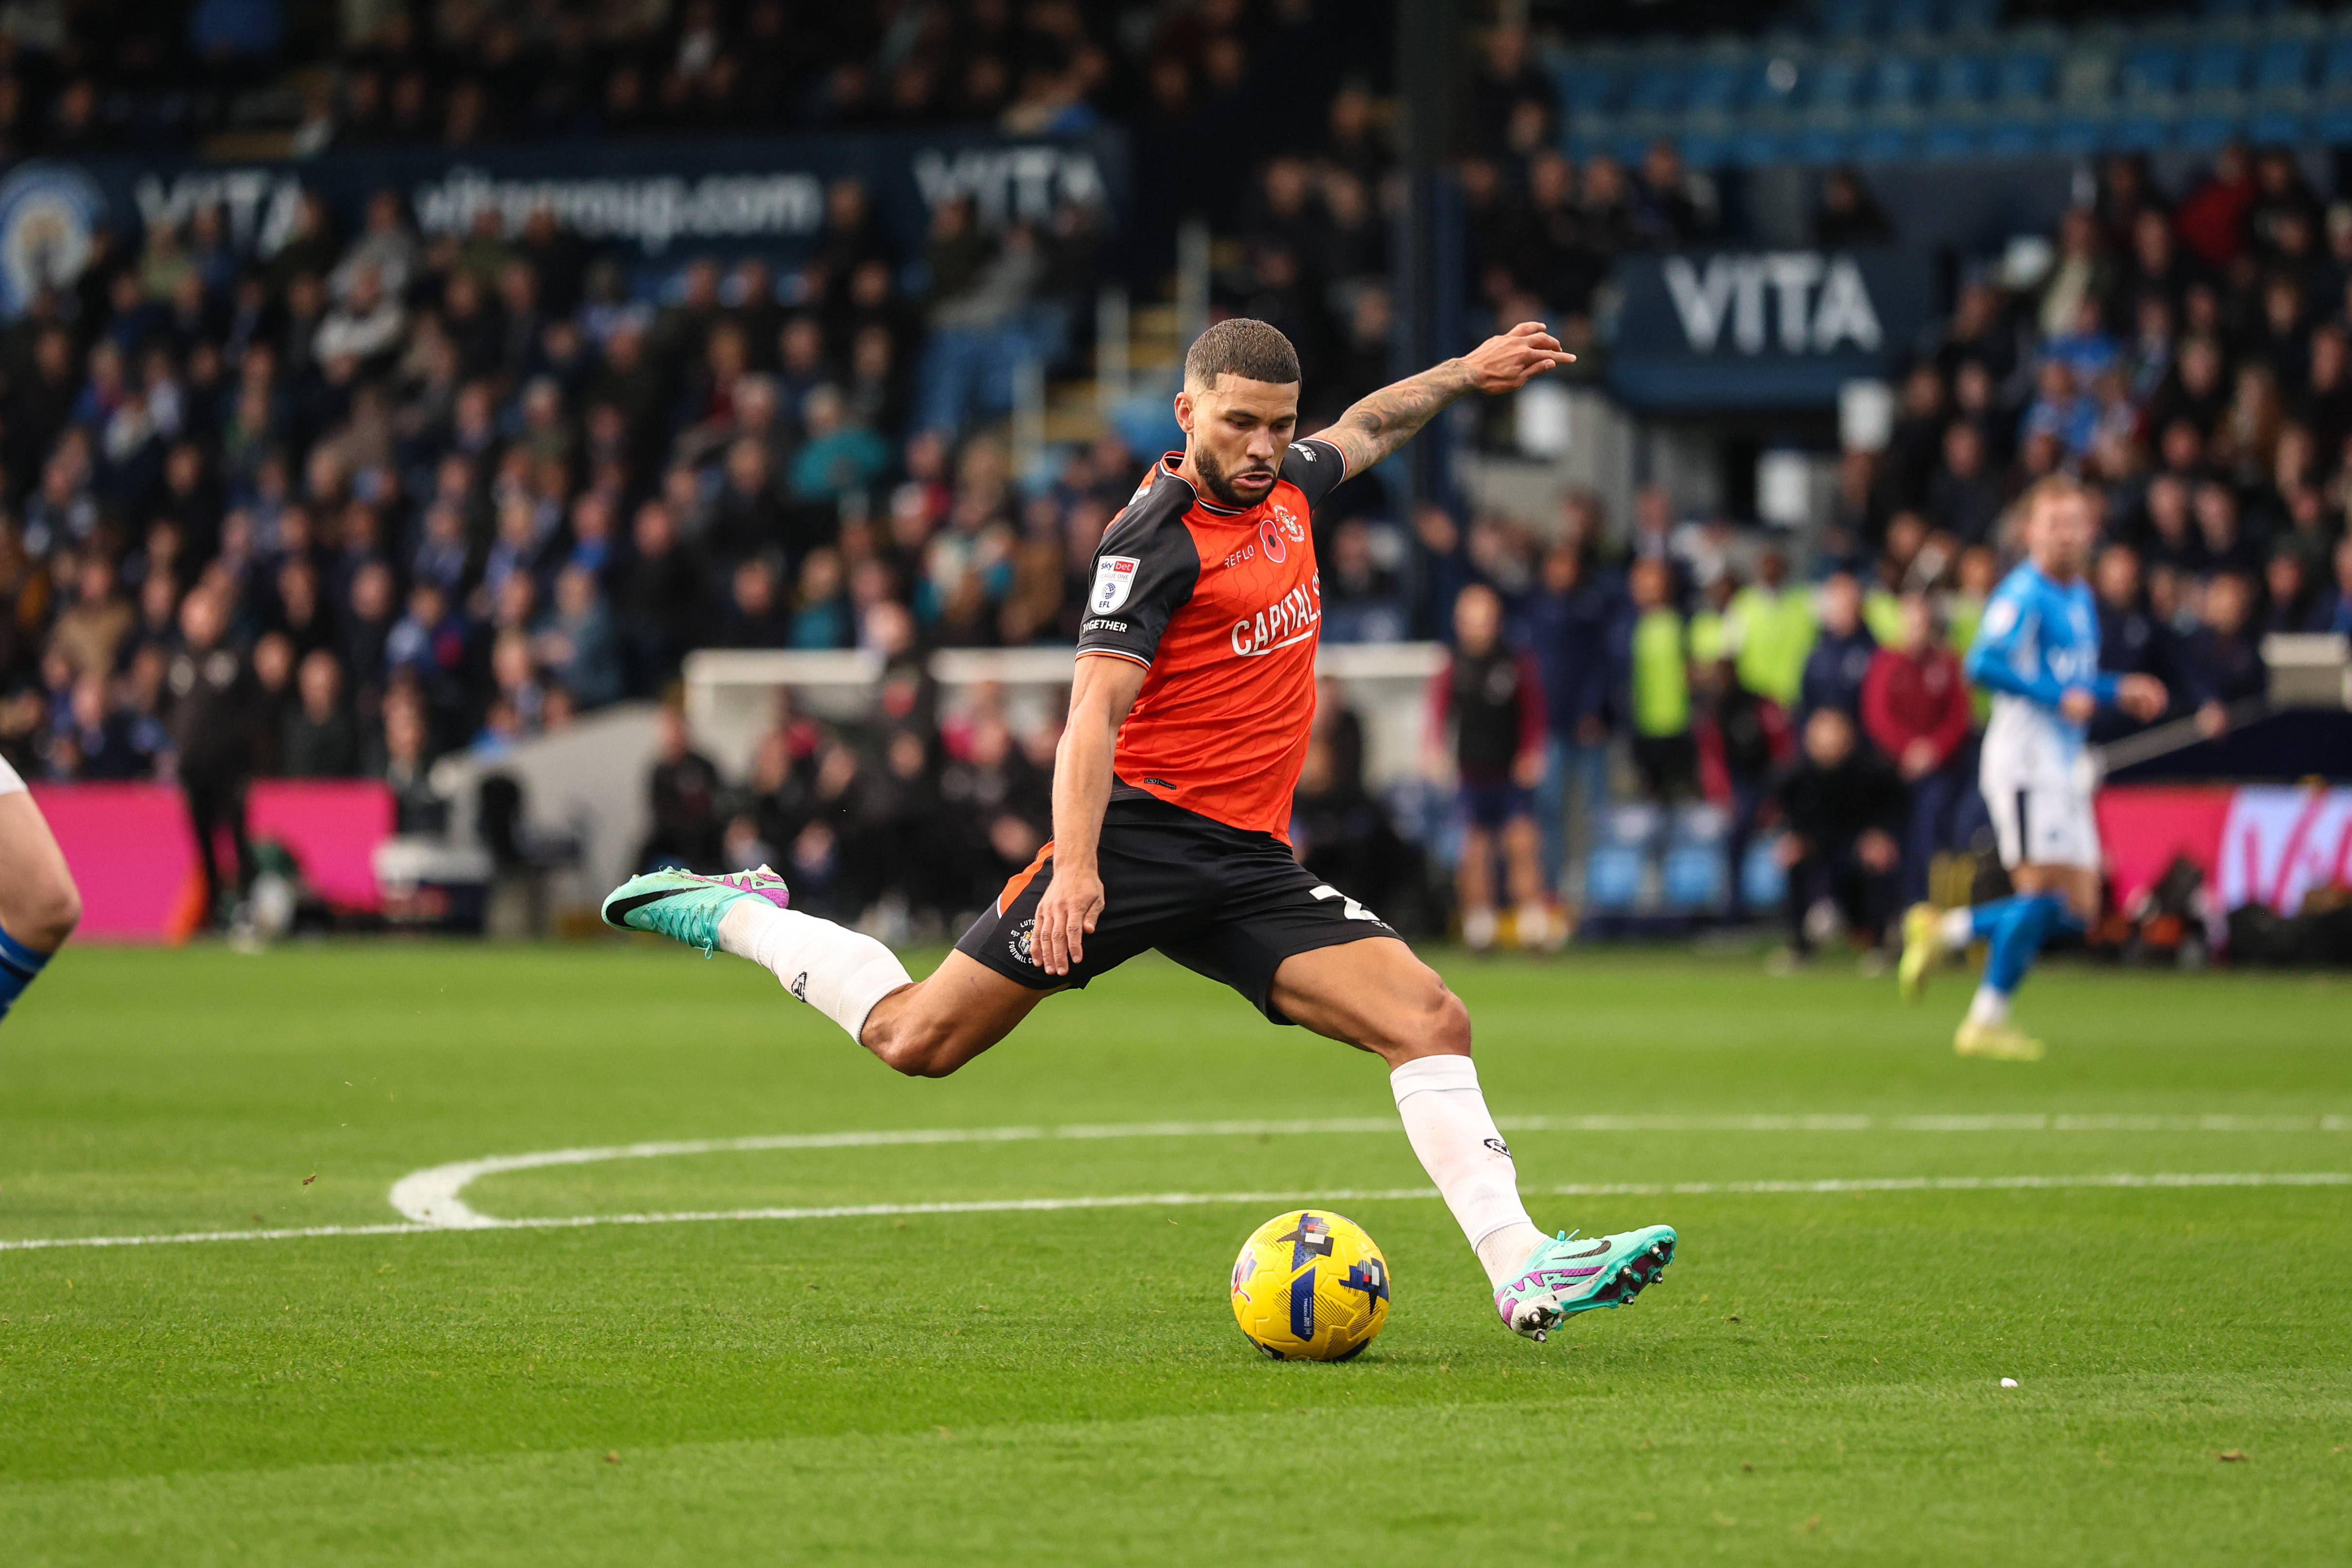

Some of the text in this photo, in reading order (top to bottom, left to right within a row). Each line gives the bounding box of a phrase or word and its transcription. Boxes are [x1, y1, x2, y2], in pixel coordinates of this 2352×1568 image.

[1662, 249, 1883, 354] VITA
[1101, 561, 1132, 571] sky bet
[1224, 545, 1254, 568] REFLO
[1232, 583, 1318, 655] CAPITAL
[1020, 919, 1035, 928] LUTO
[1008, 941, 1026, 963] FOOTBALL
